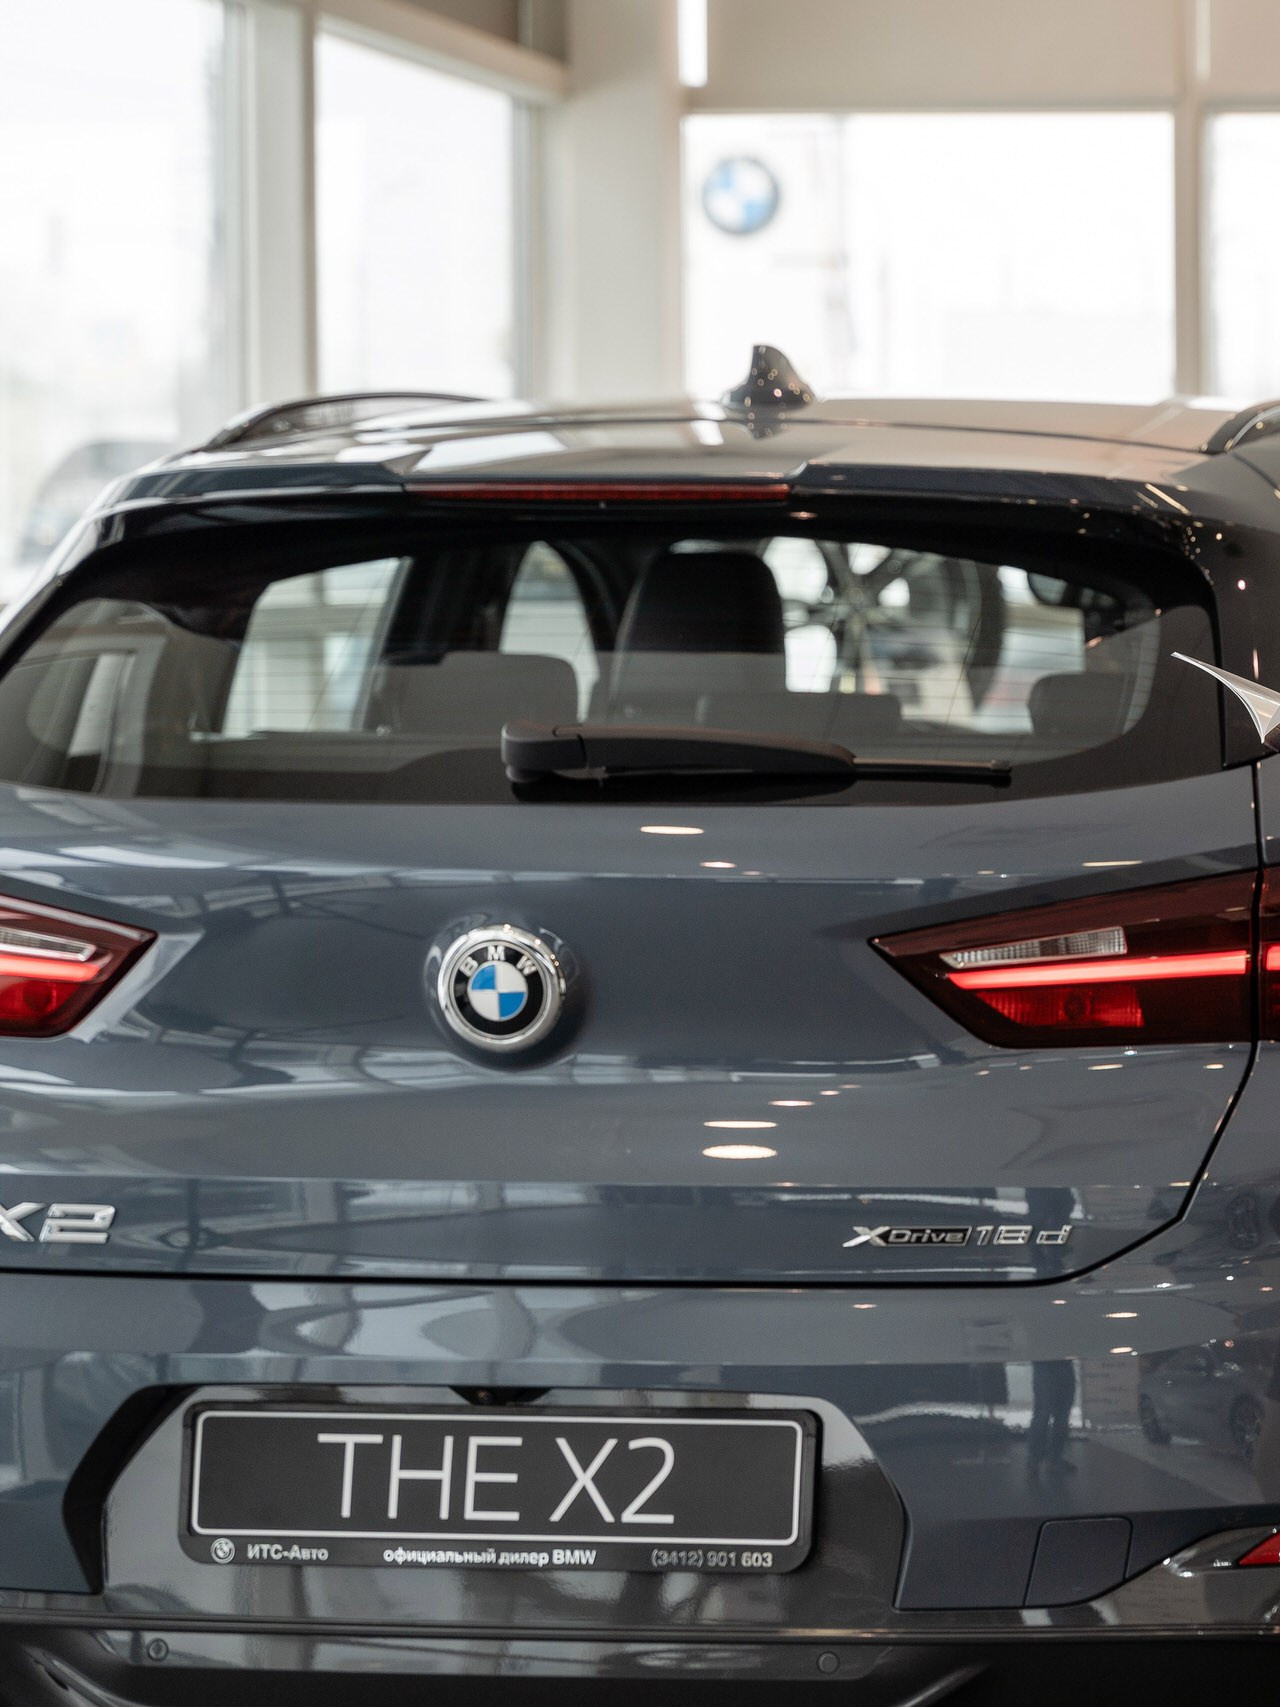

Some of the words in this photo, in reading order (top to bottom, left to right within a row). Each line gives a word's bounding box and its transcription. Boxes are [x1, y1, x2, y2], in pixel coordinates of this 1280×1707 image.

[459, 946, 538, 977] BMW
[317, 1433, 523, 1522] THE
[549, 1437, 675, 1525] X2
[246, 1543, 329, 1561] ИТС-Авто
[382, 1546, 497, 1566] официальный
[497, 1552, 550, 1568] дилер
[551, 1549, 597, 1566] BMW
[651, 1549, 703, 1568] (3412)
[706, 1551, 737, 1567] 901
[740, 1552, 773, 1568] 603
